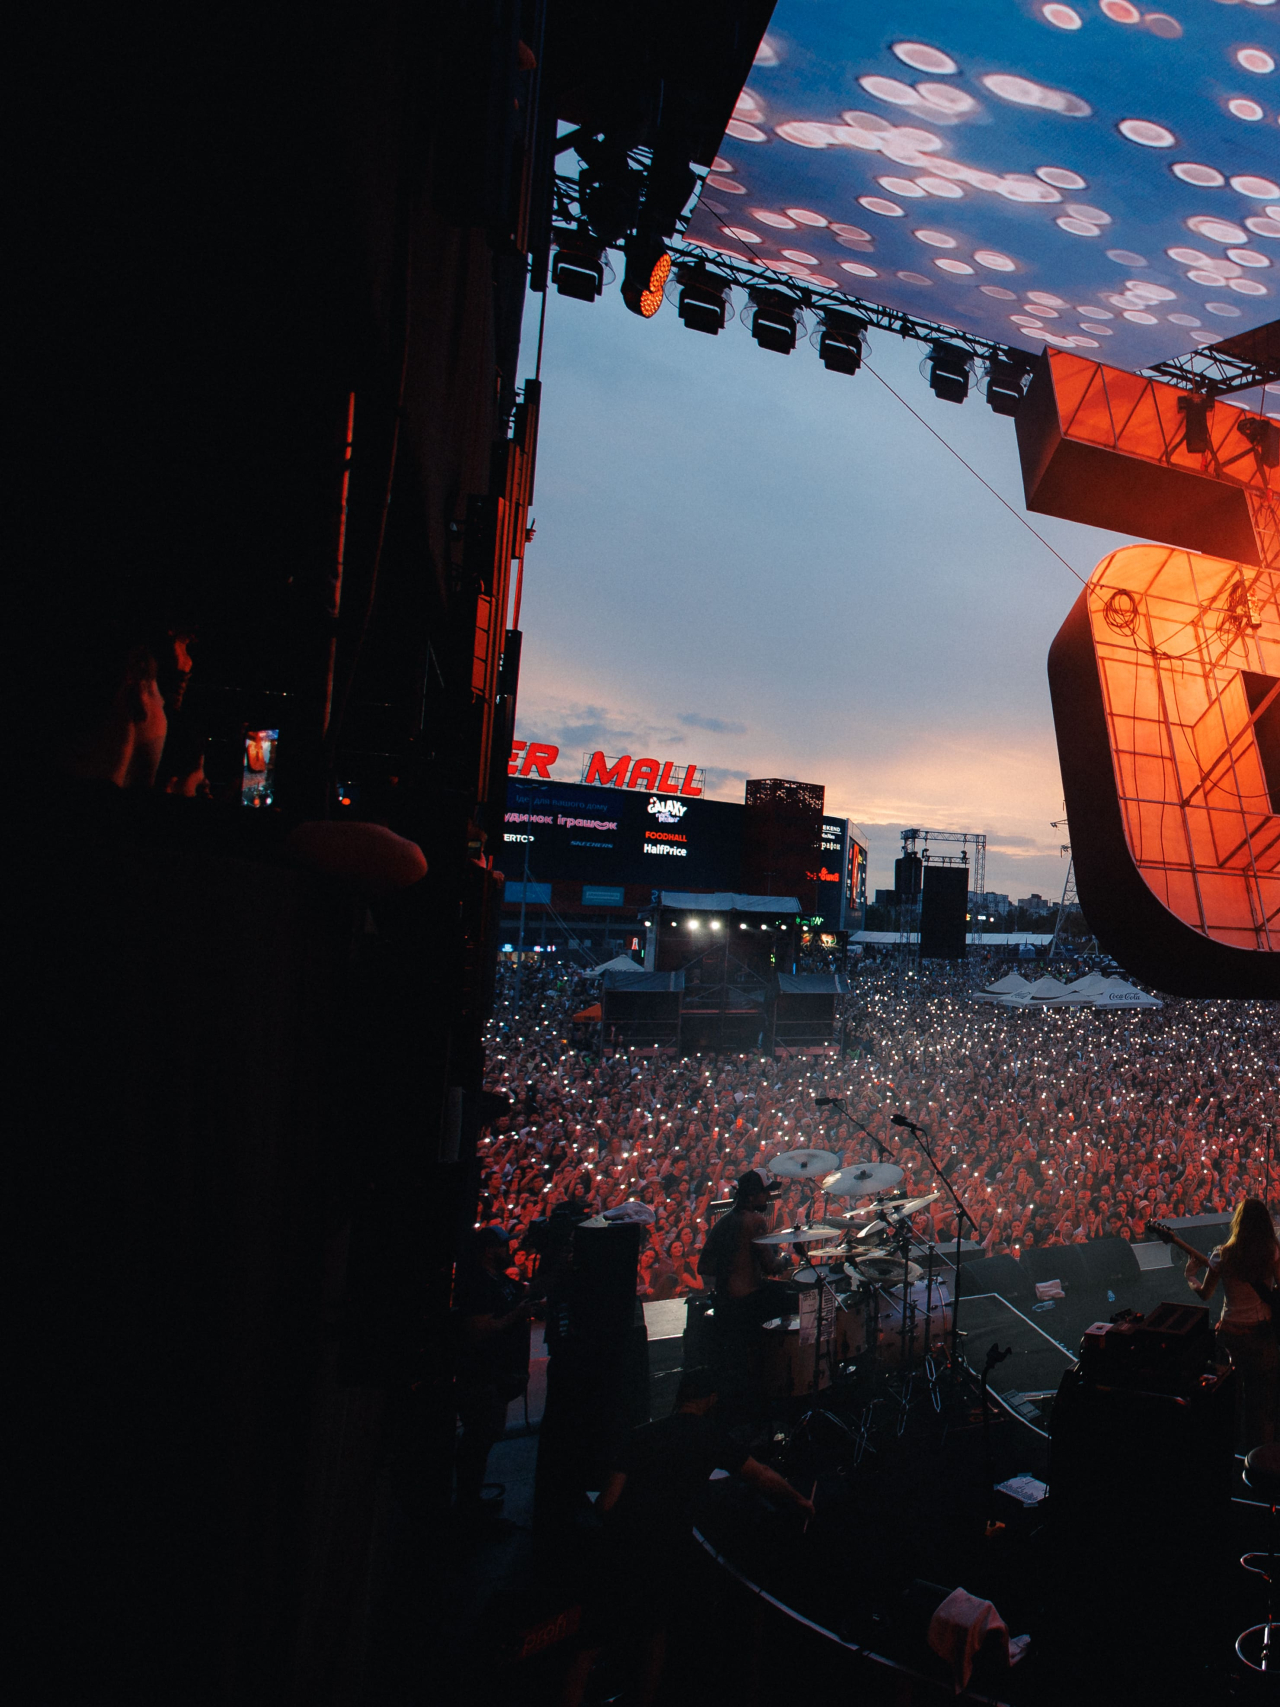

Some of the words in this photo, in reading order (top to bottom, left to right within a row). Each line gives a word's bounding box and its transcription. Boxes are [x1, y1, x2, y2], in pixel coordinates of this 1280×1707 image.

[585, 751, 702, 796] MALL
[586, 804, 608, 812] дому
[647, 797, 688, 817] GALAXY
[645, 831, 688, 842] FOODHALL
[643, 843, 687, 857] HalfPrice
